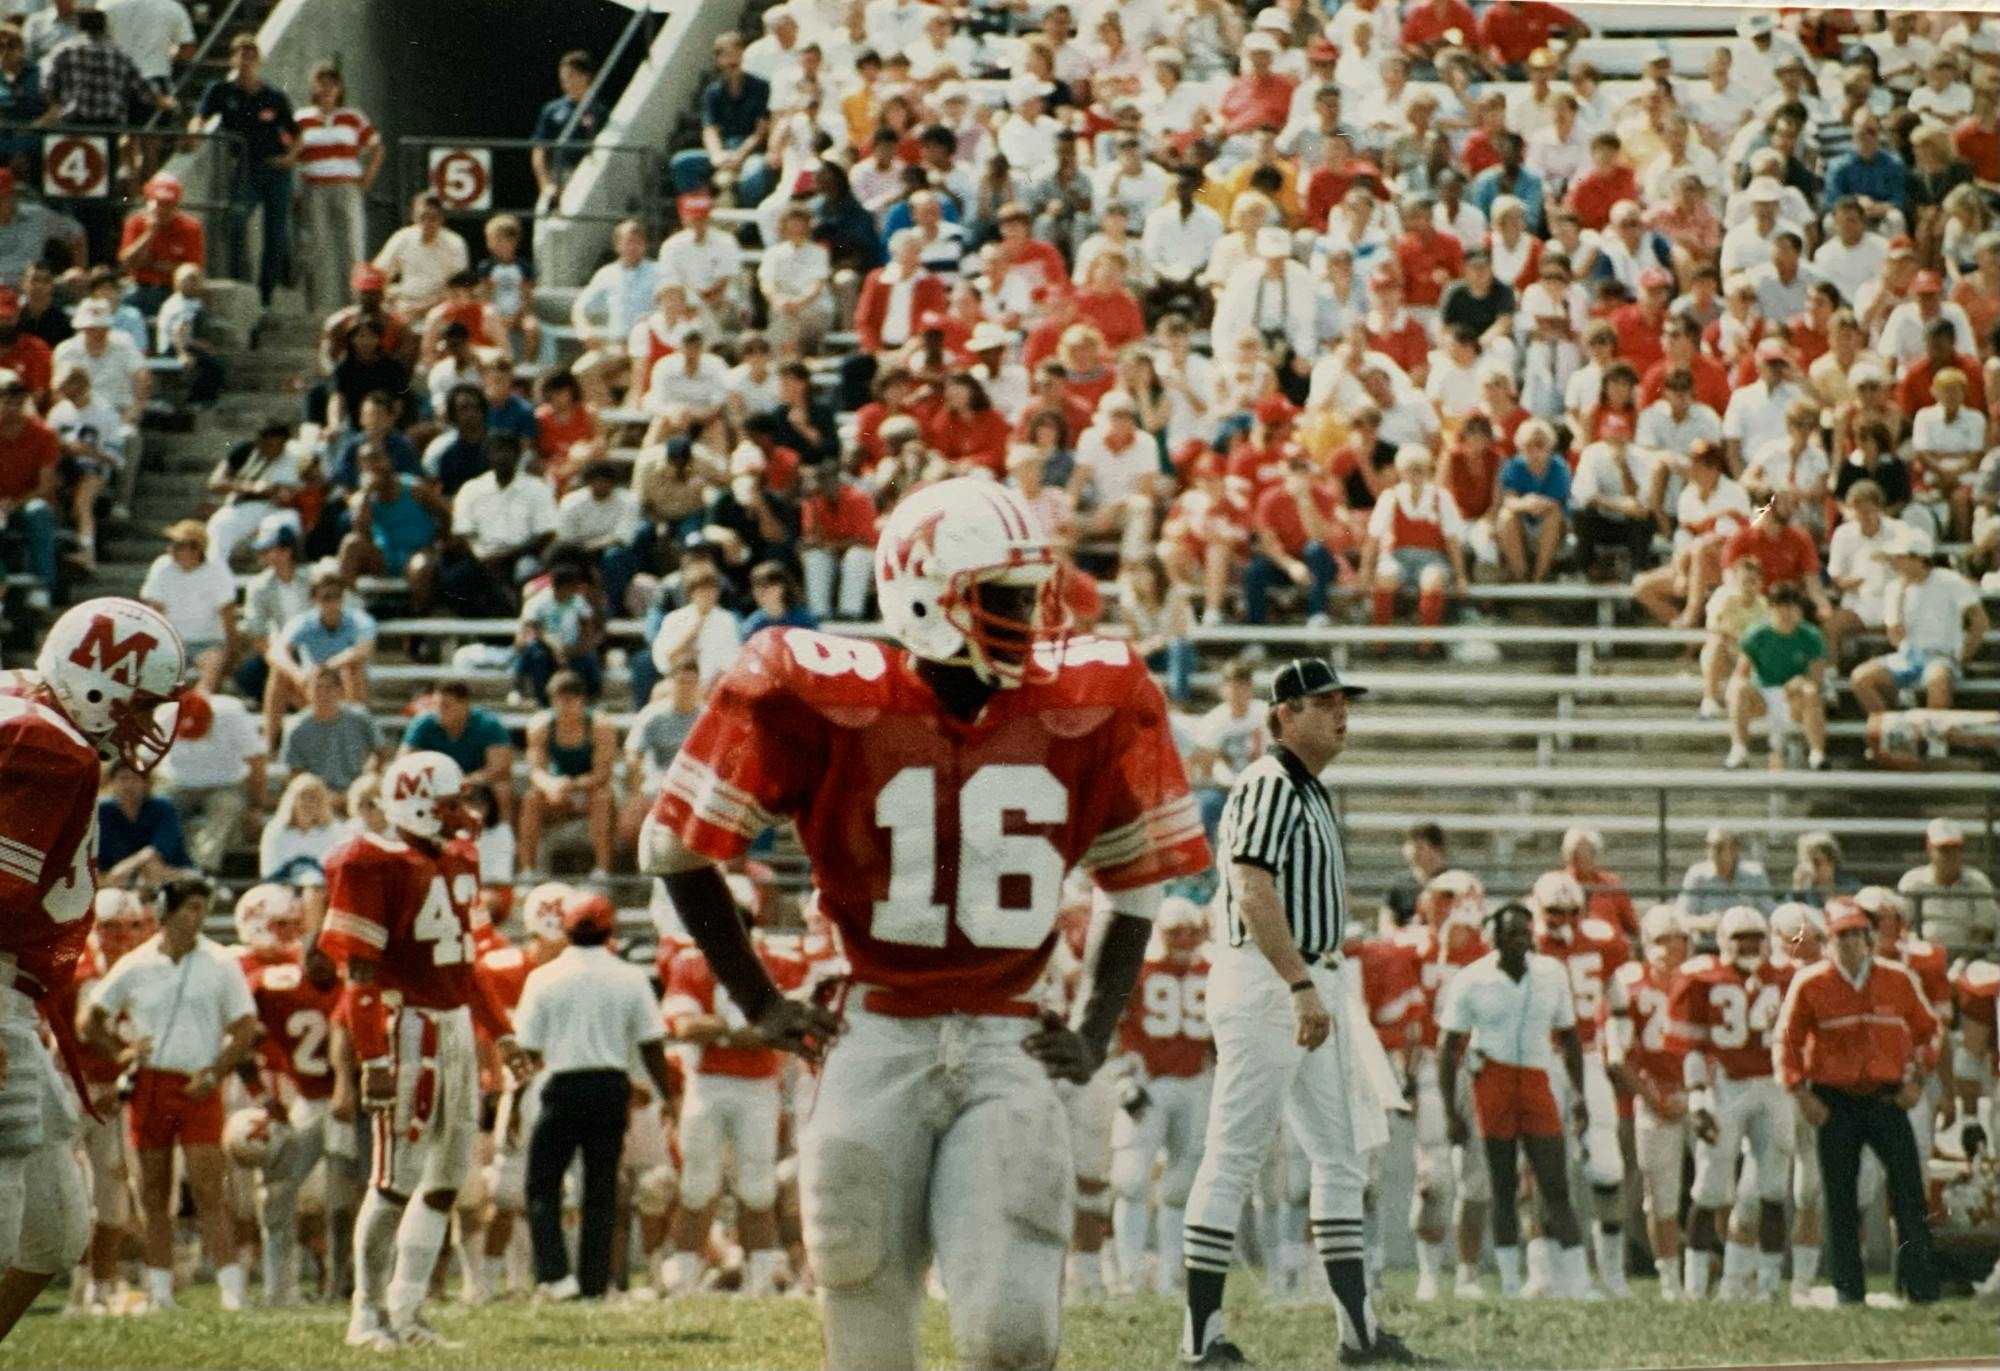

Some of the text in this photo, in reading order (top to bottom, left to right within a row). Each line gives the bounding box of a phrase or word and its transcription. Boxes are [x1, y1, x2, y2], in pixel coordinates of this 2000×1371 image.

[58, 145, 90, 186] 4
[445, 160, 477, 200] 5
[68, 613, 159, 688] M
[394, 766, 435, 801] M
[870, 763, 1069, 950] 16
[286, 1009, 328, 1077] 2
